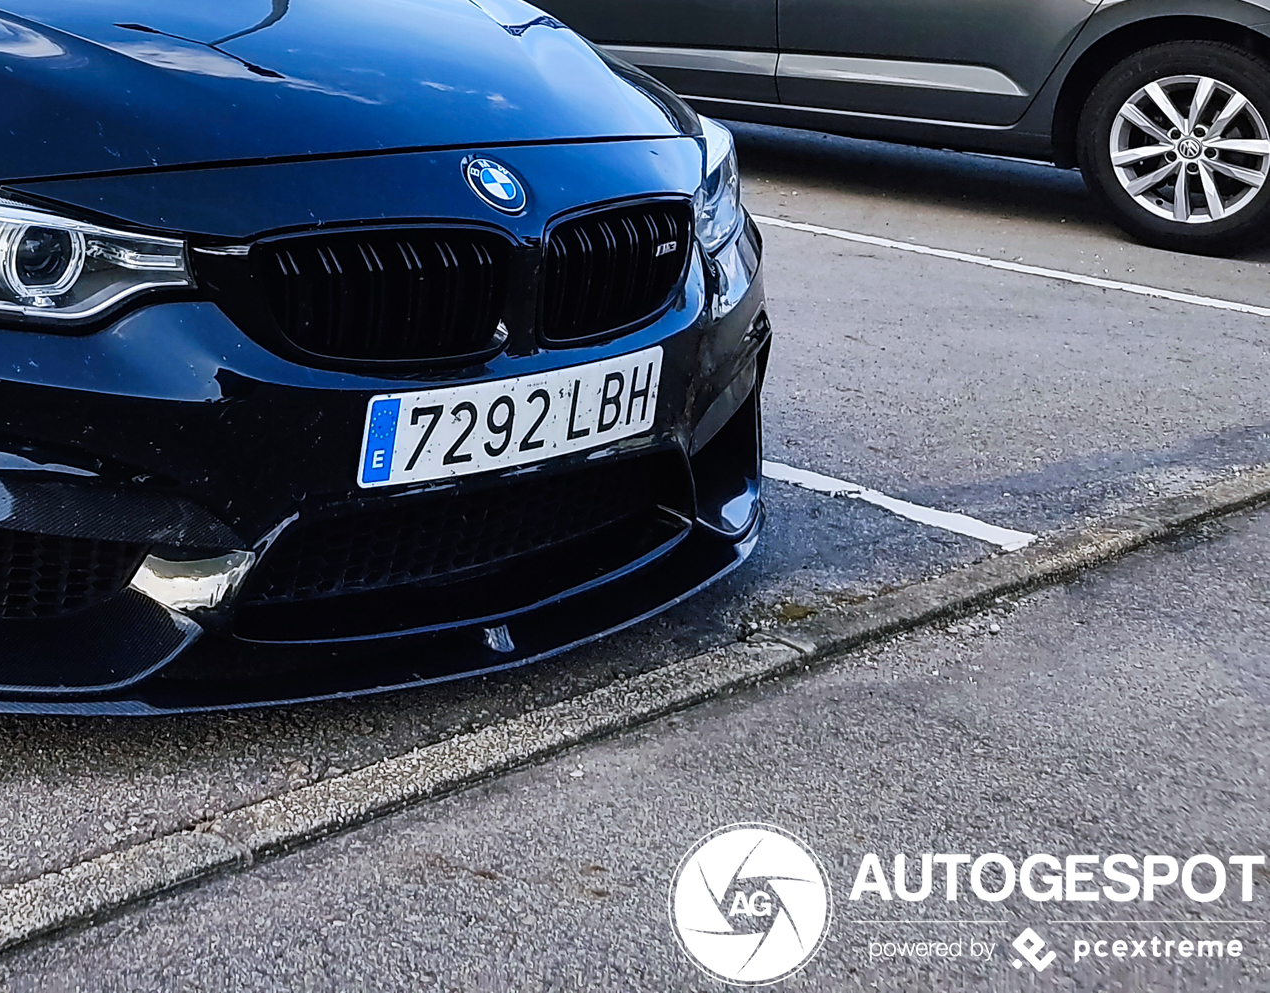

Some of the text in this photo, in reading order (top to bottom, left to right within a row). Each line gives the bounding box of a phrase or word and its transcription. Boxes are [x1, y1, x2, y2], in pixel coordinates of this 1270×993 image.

[470, 159, 510, 178] BMW
[404, 362, 654, 472] 7292 LBH
[371, 449, 386, 469] E
